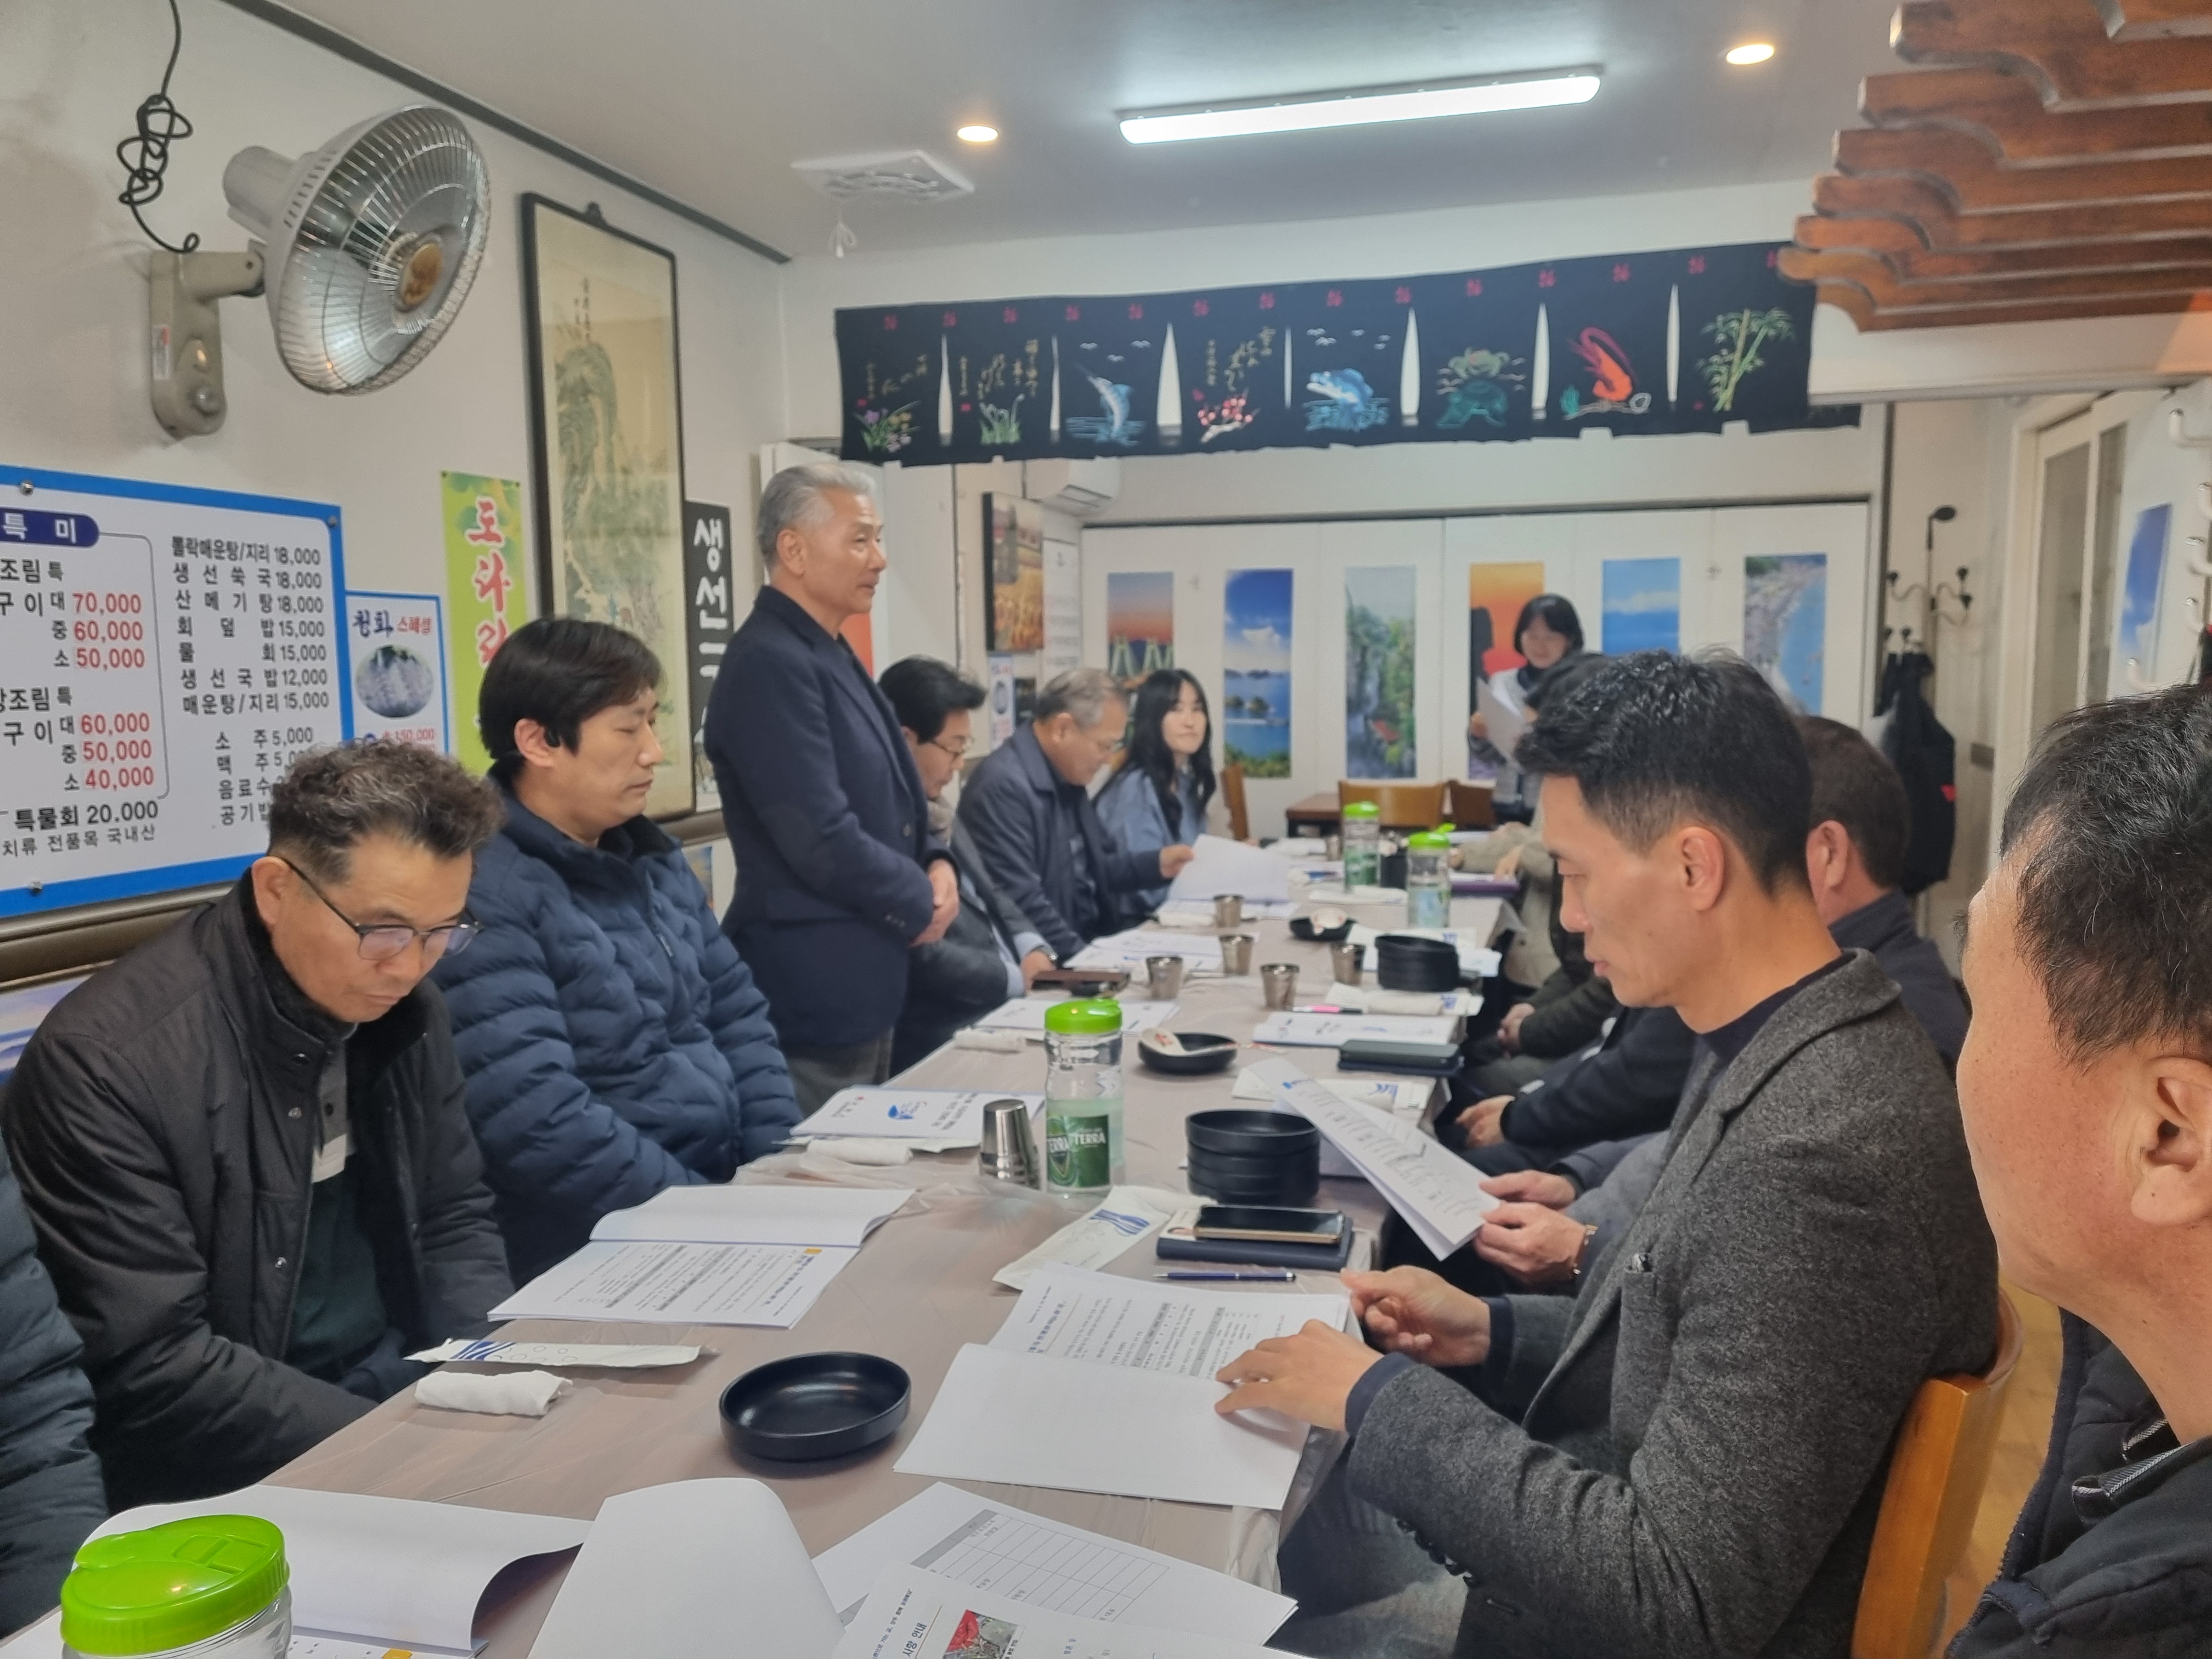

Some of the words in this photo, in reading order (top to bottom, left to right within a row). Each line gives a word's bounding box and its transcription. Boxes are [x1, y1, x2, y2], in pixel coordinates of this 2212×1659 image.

[274, 546, 321, 566] 18,000
[276, 571, 323, 590] 18,000
[50, 591, 65, 611] 대
[72, 592, 142, 616] 70,000
[276, 595, 324, 614] 18,000
[74, 620, 144, 644] 60,000
[279, 619, 325, 639] 15,000
[54, 648, 70, 667] 소
[76, 648, 145, 672] 50,000
[280, 644, 326, 663] 15,000
[281, 668, 328, 688] 12,000
[283, 691, 329, 712] 15,000
[60, 715, 75, 735] 대
[81, 713, 150, 736] 60,000
[272, 726, 313, 747] 5,000
[83, 740, 152, 764] 50,000
[64, 773, 80, 792] 소
[85, 766, 154, 791] 40,000
[108, 824, 156, 845] 국내산
[1068, 1132, 1106, 1146] TERRA
[912, 1623, 927, 1638] 안내
